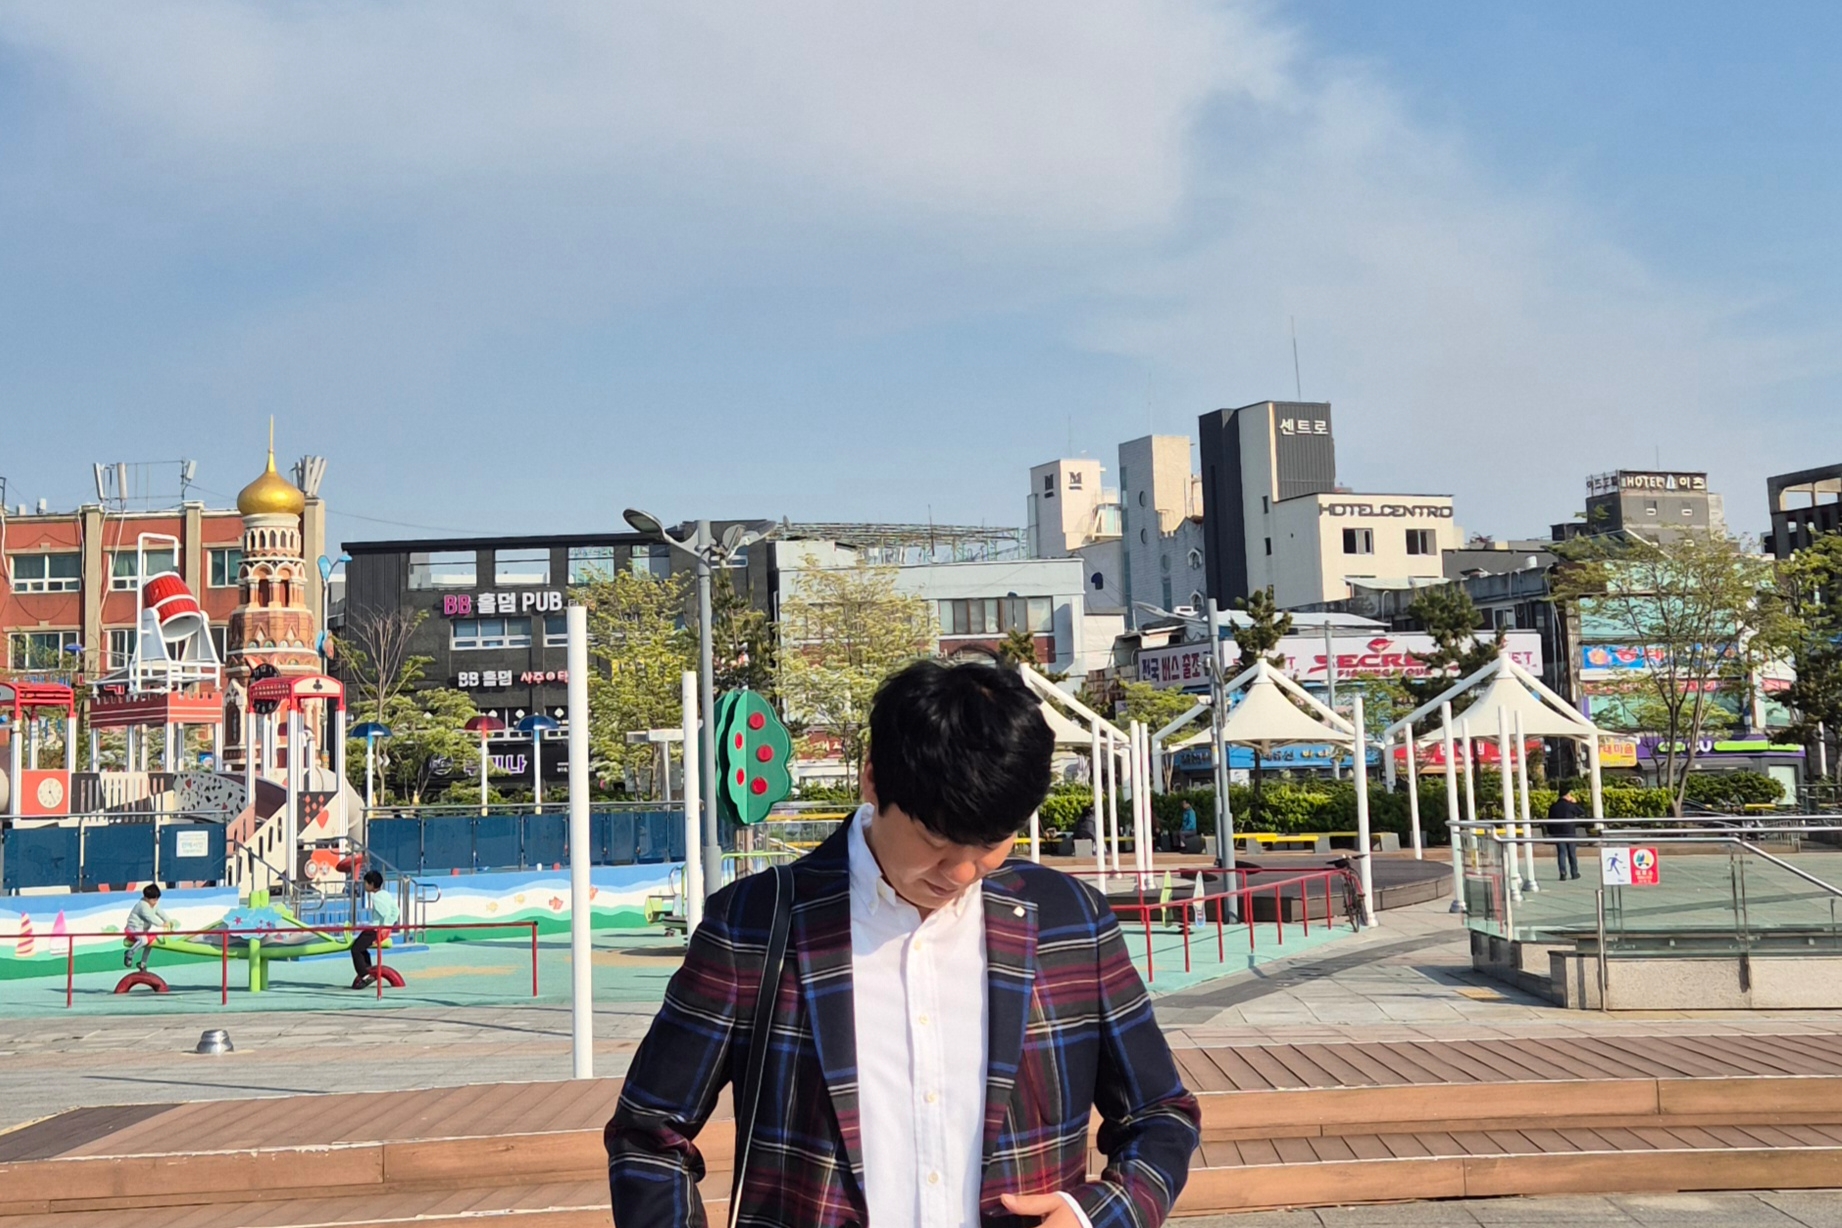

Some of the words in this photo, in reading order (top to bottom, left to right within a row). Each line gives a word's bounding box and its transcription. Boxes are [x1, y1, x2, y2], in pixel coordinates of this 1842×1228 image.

[1280, 418, 1329, 436] 센트로
[1626, 475, 1665, 489] HOTEL
[444, 594, 472, 615] BB
[477, 592, 516, 614] 홀덤
[521, 591, 563, 612] PUB
[1142, 658, 1159, 682] 전국
[1162, 656, 1180, 681] 버스
[458, 672, 479, 687] BB
